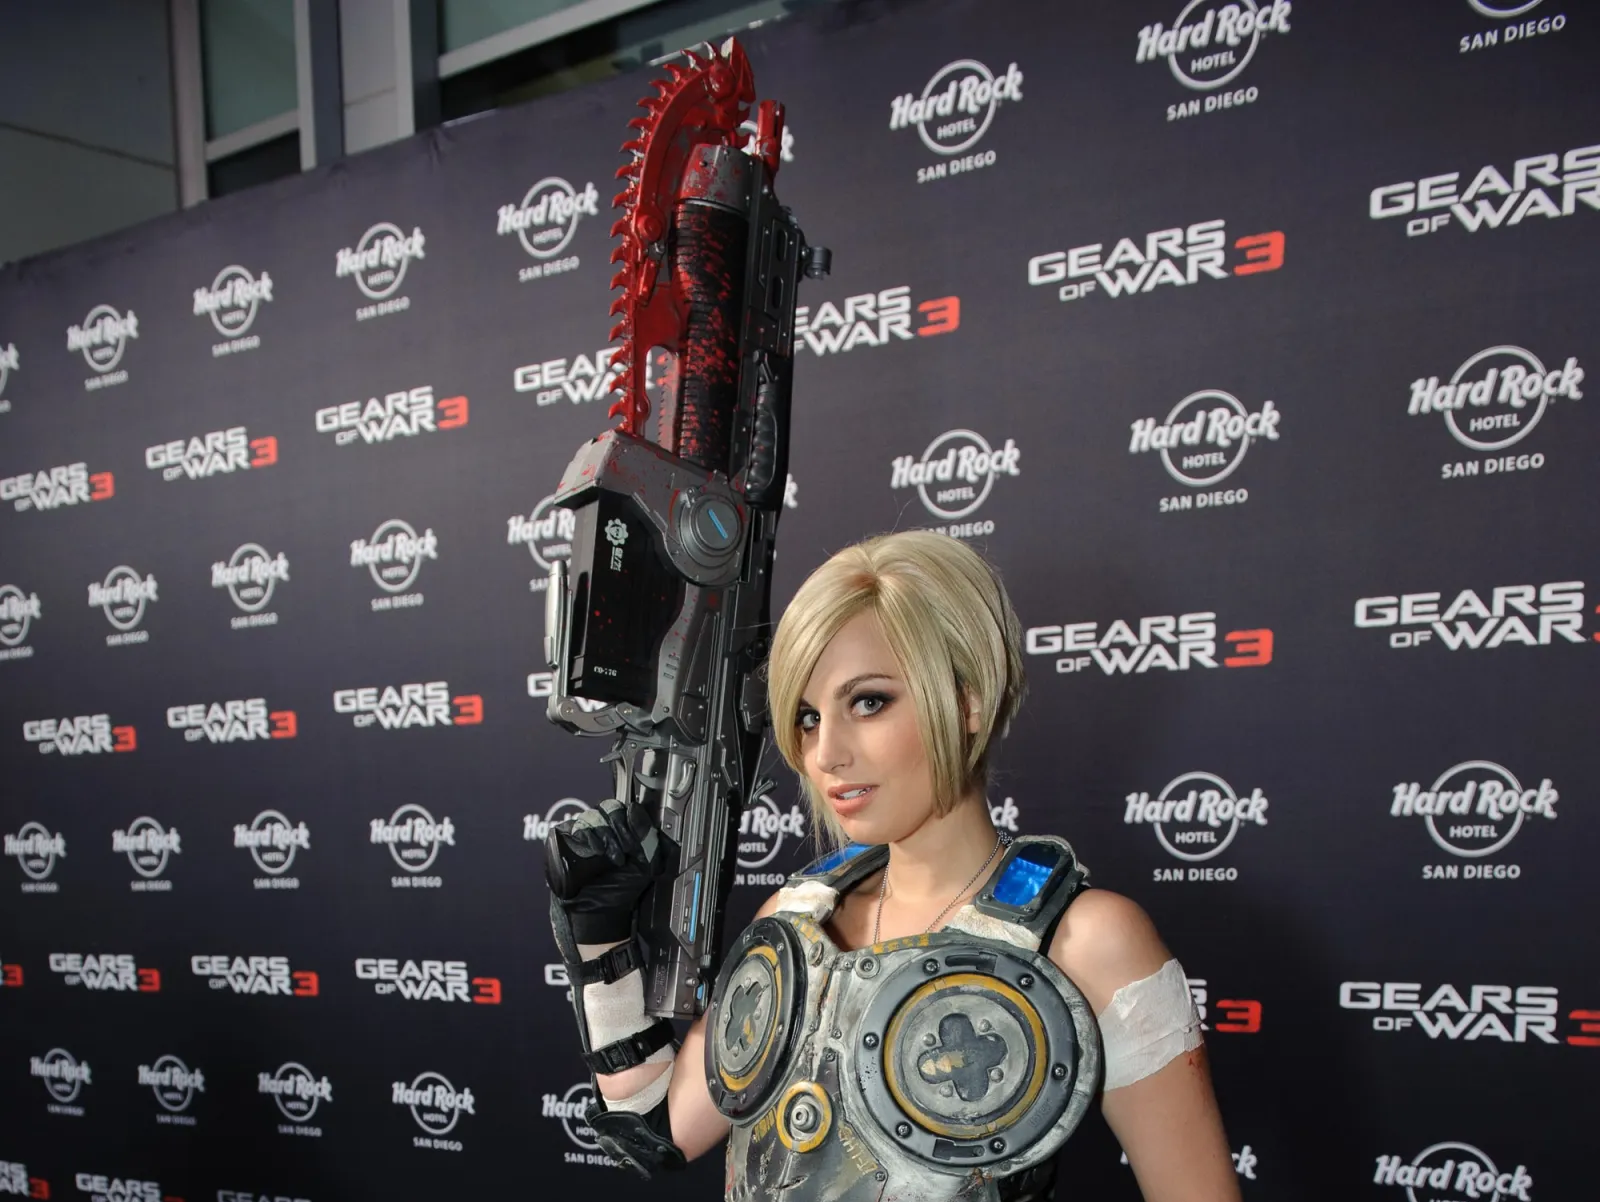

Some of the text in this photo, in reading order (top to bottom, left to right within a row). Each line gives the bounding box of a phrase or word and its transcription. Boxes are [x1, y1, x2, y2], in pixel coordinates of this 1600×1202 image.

[1135, 0, 1292, 62] Hard Rock
[1459, 12, 1568, 53] SAN DIEGO
[1190, 50, 1236, 72] HOTEL
[889, 62, 1023, 130] Hard Rock
[1166, 86, 1258, 120] SAN DIEGO
[936, 117, 976, 139] HOTEL
[917, 150, 996, 183] SAN DIEGO
[1369, 143, 1600, 219] GEARS
[496, 181, 598, 235] Hard Rock
[1406, 176, 1600, 237] OF WAR
[335, 227, 425, 277] Hard Rock
[1027, 218, 1226, 285] GEARS
[1058, 230, 1285, 301] OF WAR 3
[192, 271, 272, 314] Hard Rock
[801, 295, 959, 356] WAR 3
[536, 387, 563, 406] OF
[1407, 356, 1584, 415] Hard Rock
[315, 385, 433, 432] GEARS
[335, 395, 468, 445] OF WAR 3
[1468, 412, 1521, 432] HOTEL
[1128, 399, 1280, 453] Hard Rock
[144, 425, 247, 468] GEARS
[179, 435, 277, 479] WAR 3
[890, 438, 1020, 488] Hard Rock
[1182, 451, 1226, 469] HOTEL
[0, 461, 87, 499] GEARS
[1441, 452, 1545, 479] SAN DIEGO
[28, 471, 114, 511] WAR 3
[936, 486, 975, 502] HOTEL
[1159, 487, 1248, 512] SAN DIEGO
[507, 510, 555, 544] Hard
[949, 519, 994, 538] DIEGO
[349, 528, 437, 566] Hard Rock
[210, 551, 289, 587] Hard Rock
[1353, 579, 1586, 628] GEARS
[1025, 611, 1216, 655] GEARS
[1388, 629, 1433, 648] OF
[1427, 610, 1587, 651] WAR
[1055, 628, 1274, 675] OF WAR 3
[166, 697, 267, 728] GEARS
[333, 680, 449, 712] GEARS
[353, 694, 483, 729] OF WAR 3
[22, 713, 110, 741] GEARS
[52, 725, 136, 755] WAR 3
[200, 710, 297, 743] WAR 3
[1123, 786, 1268, 828] Hard Rock
[1389, 776, 1559, 822] Hard Rock
[232, 820, 310, 851] Hard Rock
[369, 815, 455, 847] Hard Rock
[752, 804, 805, 840] Rock
[1174, 830, 1217, 844] HOTEL
[1448, 824, 1498, 838] HOTEL
[390, 875, 442, 888] SAN DIEGO
[747, 871, 785, 886] DIEGO
[1152, 866, 1238, 882] SAN DIEGO
[1422, 863, 1521, 879] SAN DIEGO
[48, 953, 135, 974] GEARS
[78, 968, 161, 992] WAR 3
[190, 955, 289, 977] GEARS
[354, 957, 468, 983] GEARS
[224, 971, 319, 996] WAR 3
[374, 976, 502, 1004] OF WAR 3
[1338, 980, 1559, 1017] GEARS
[1215, 998, 1261, 1034] 3
[1371, 1015, 1414, 1032] OF
[1409, 1010, 1560, 1045] WAR
[256, 1071, 332, 1102] Hard Rock
[391, 1081, 475, 1114] Hard Rock
[541, 1092, 589, 1120] Hard
[412, 1136, 462, 1151] SAN DIEGO
[563, 1151, 584, 1164] SAN
[74, 1173, 161, 1200] GEARS
[1372, 1154, 1533, 1202] Hard Rock
